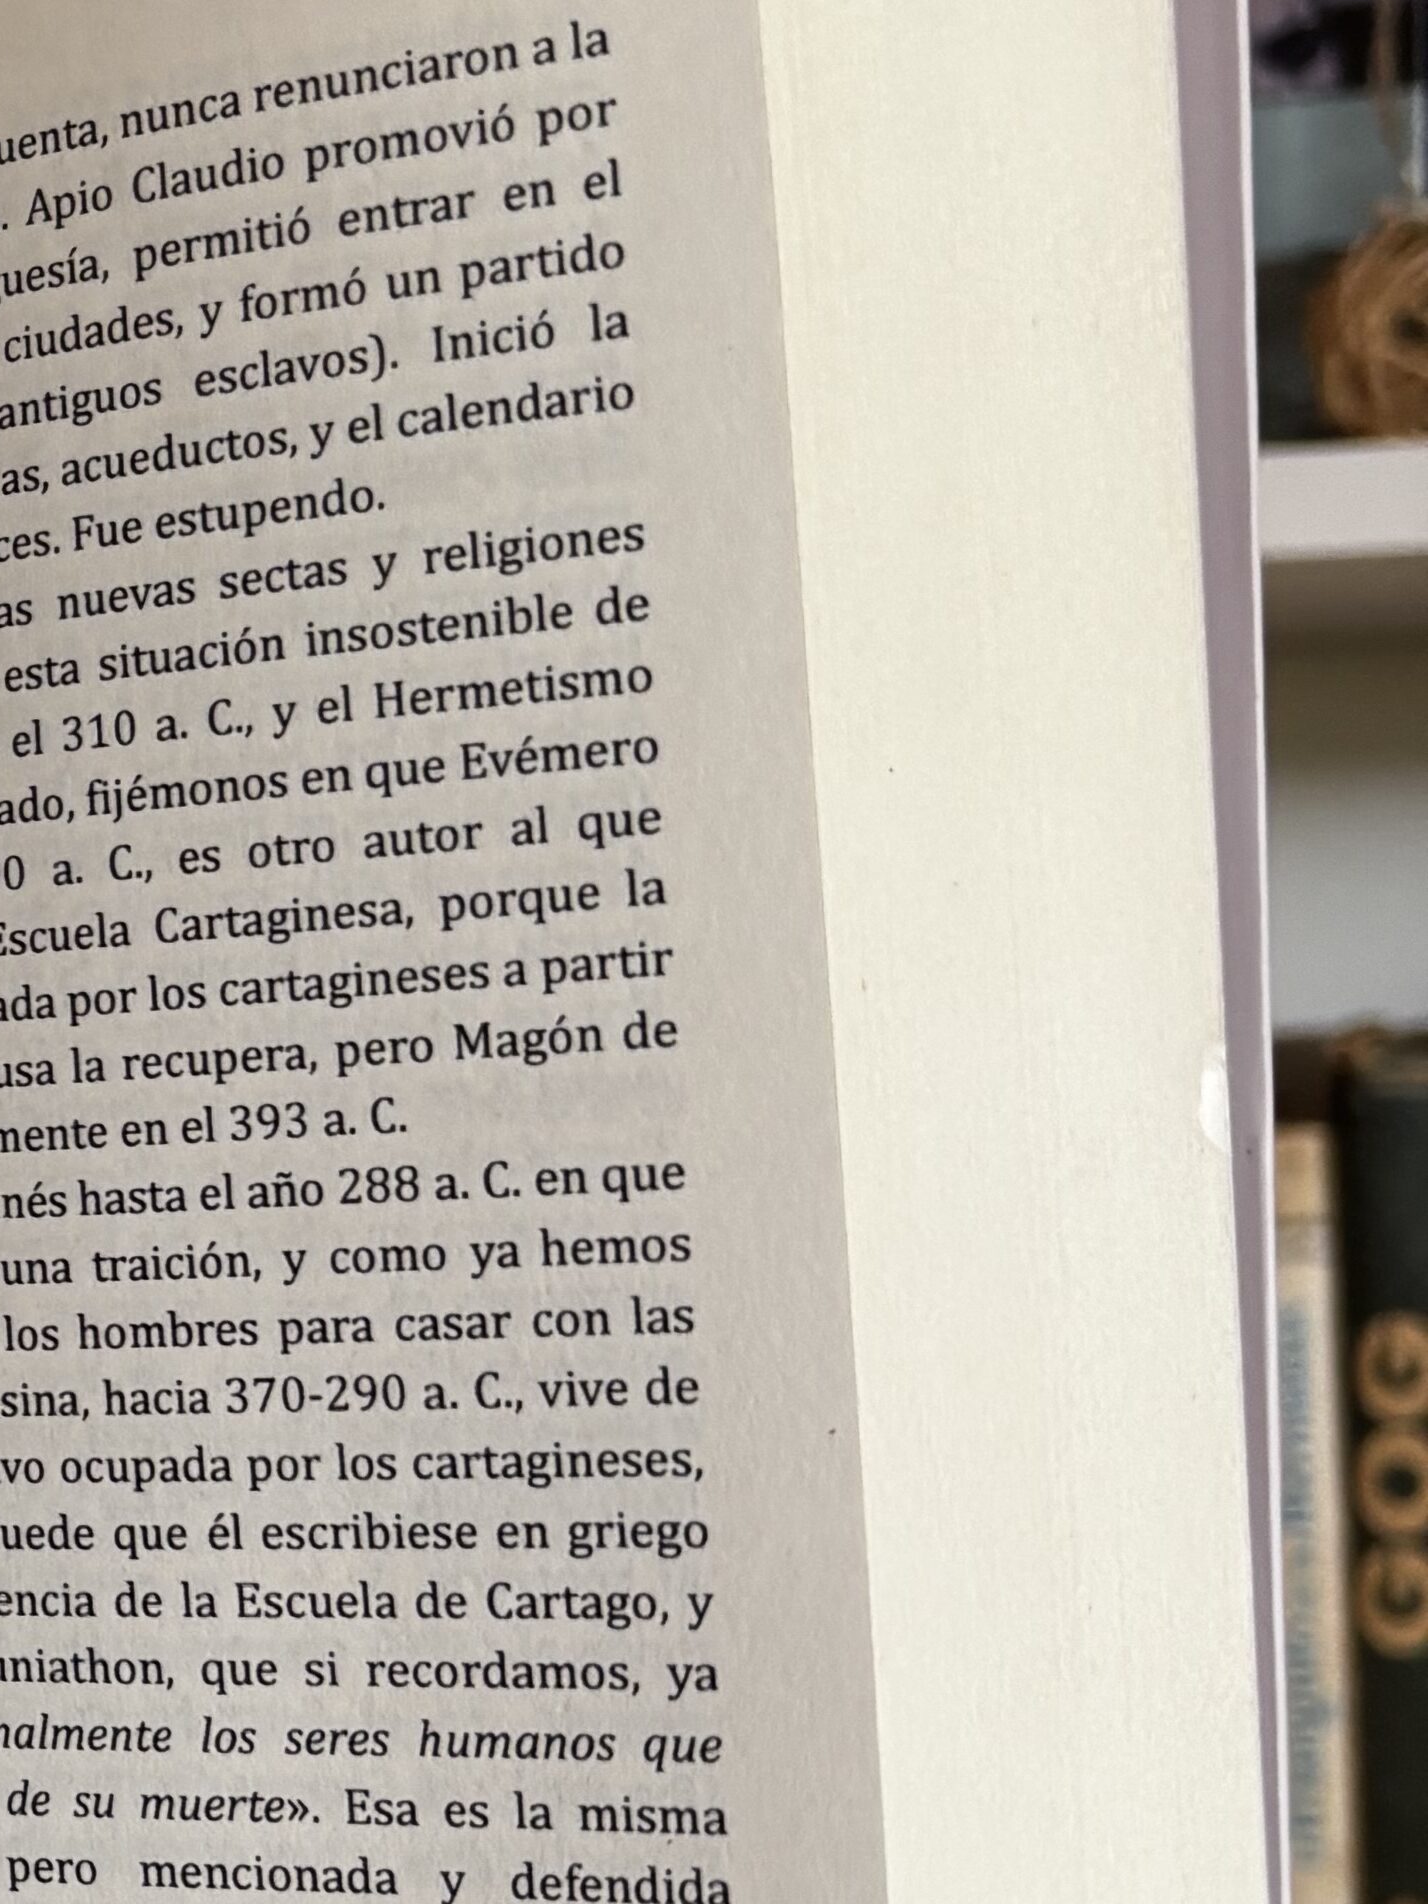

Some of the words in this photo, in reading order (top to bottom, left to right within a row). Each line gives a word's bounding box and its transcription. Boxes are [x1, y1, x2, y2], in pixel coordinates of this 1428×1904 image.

[119, 90, 242, 139] nunca
[253, 42, 520, 113] renunciaron
[532, 36, 557, 66] a
[569, 19, 611, 60] la
[194, 332, 399, 398] esclavos).
[431, 308, 555, 363] Inició
[587, 301, 630, 343] la
[120, 1119, 170, 1148] en
[181, 1104, 217, 1145] el
[229, 1101, 308, 1142] 393
[323, 1109, 357, 1138] a.
[370, 1096, 408, 1135] C.
[2, 1314, 60, 1352] los
[76, 1309, 260, 1350] hombres
[277, 1315, 375, 1356] para
[394, 1310, 513, 1342] casar
[532, 1307, 612, 1339] con
[630, 1294, 695, 1336] las
[5, 1856, 98, 1893] pero
[138, 1854, 399, 1896] mencionada
